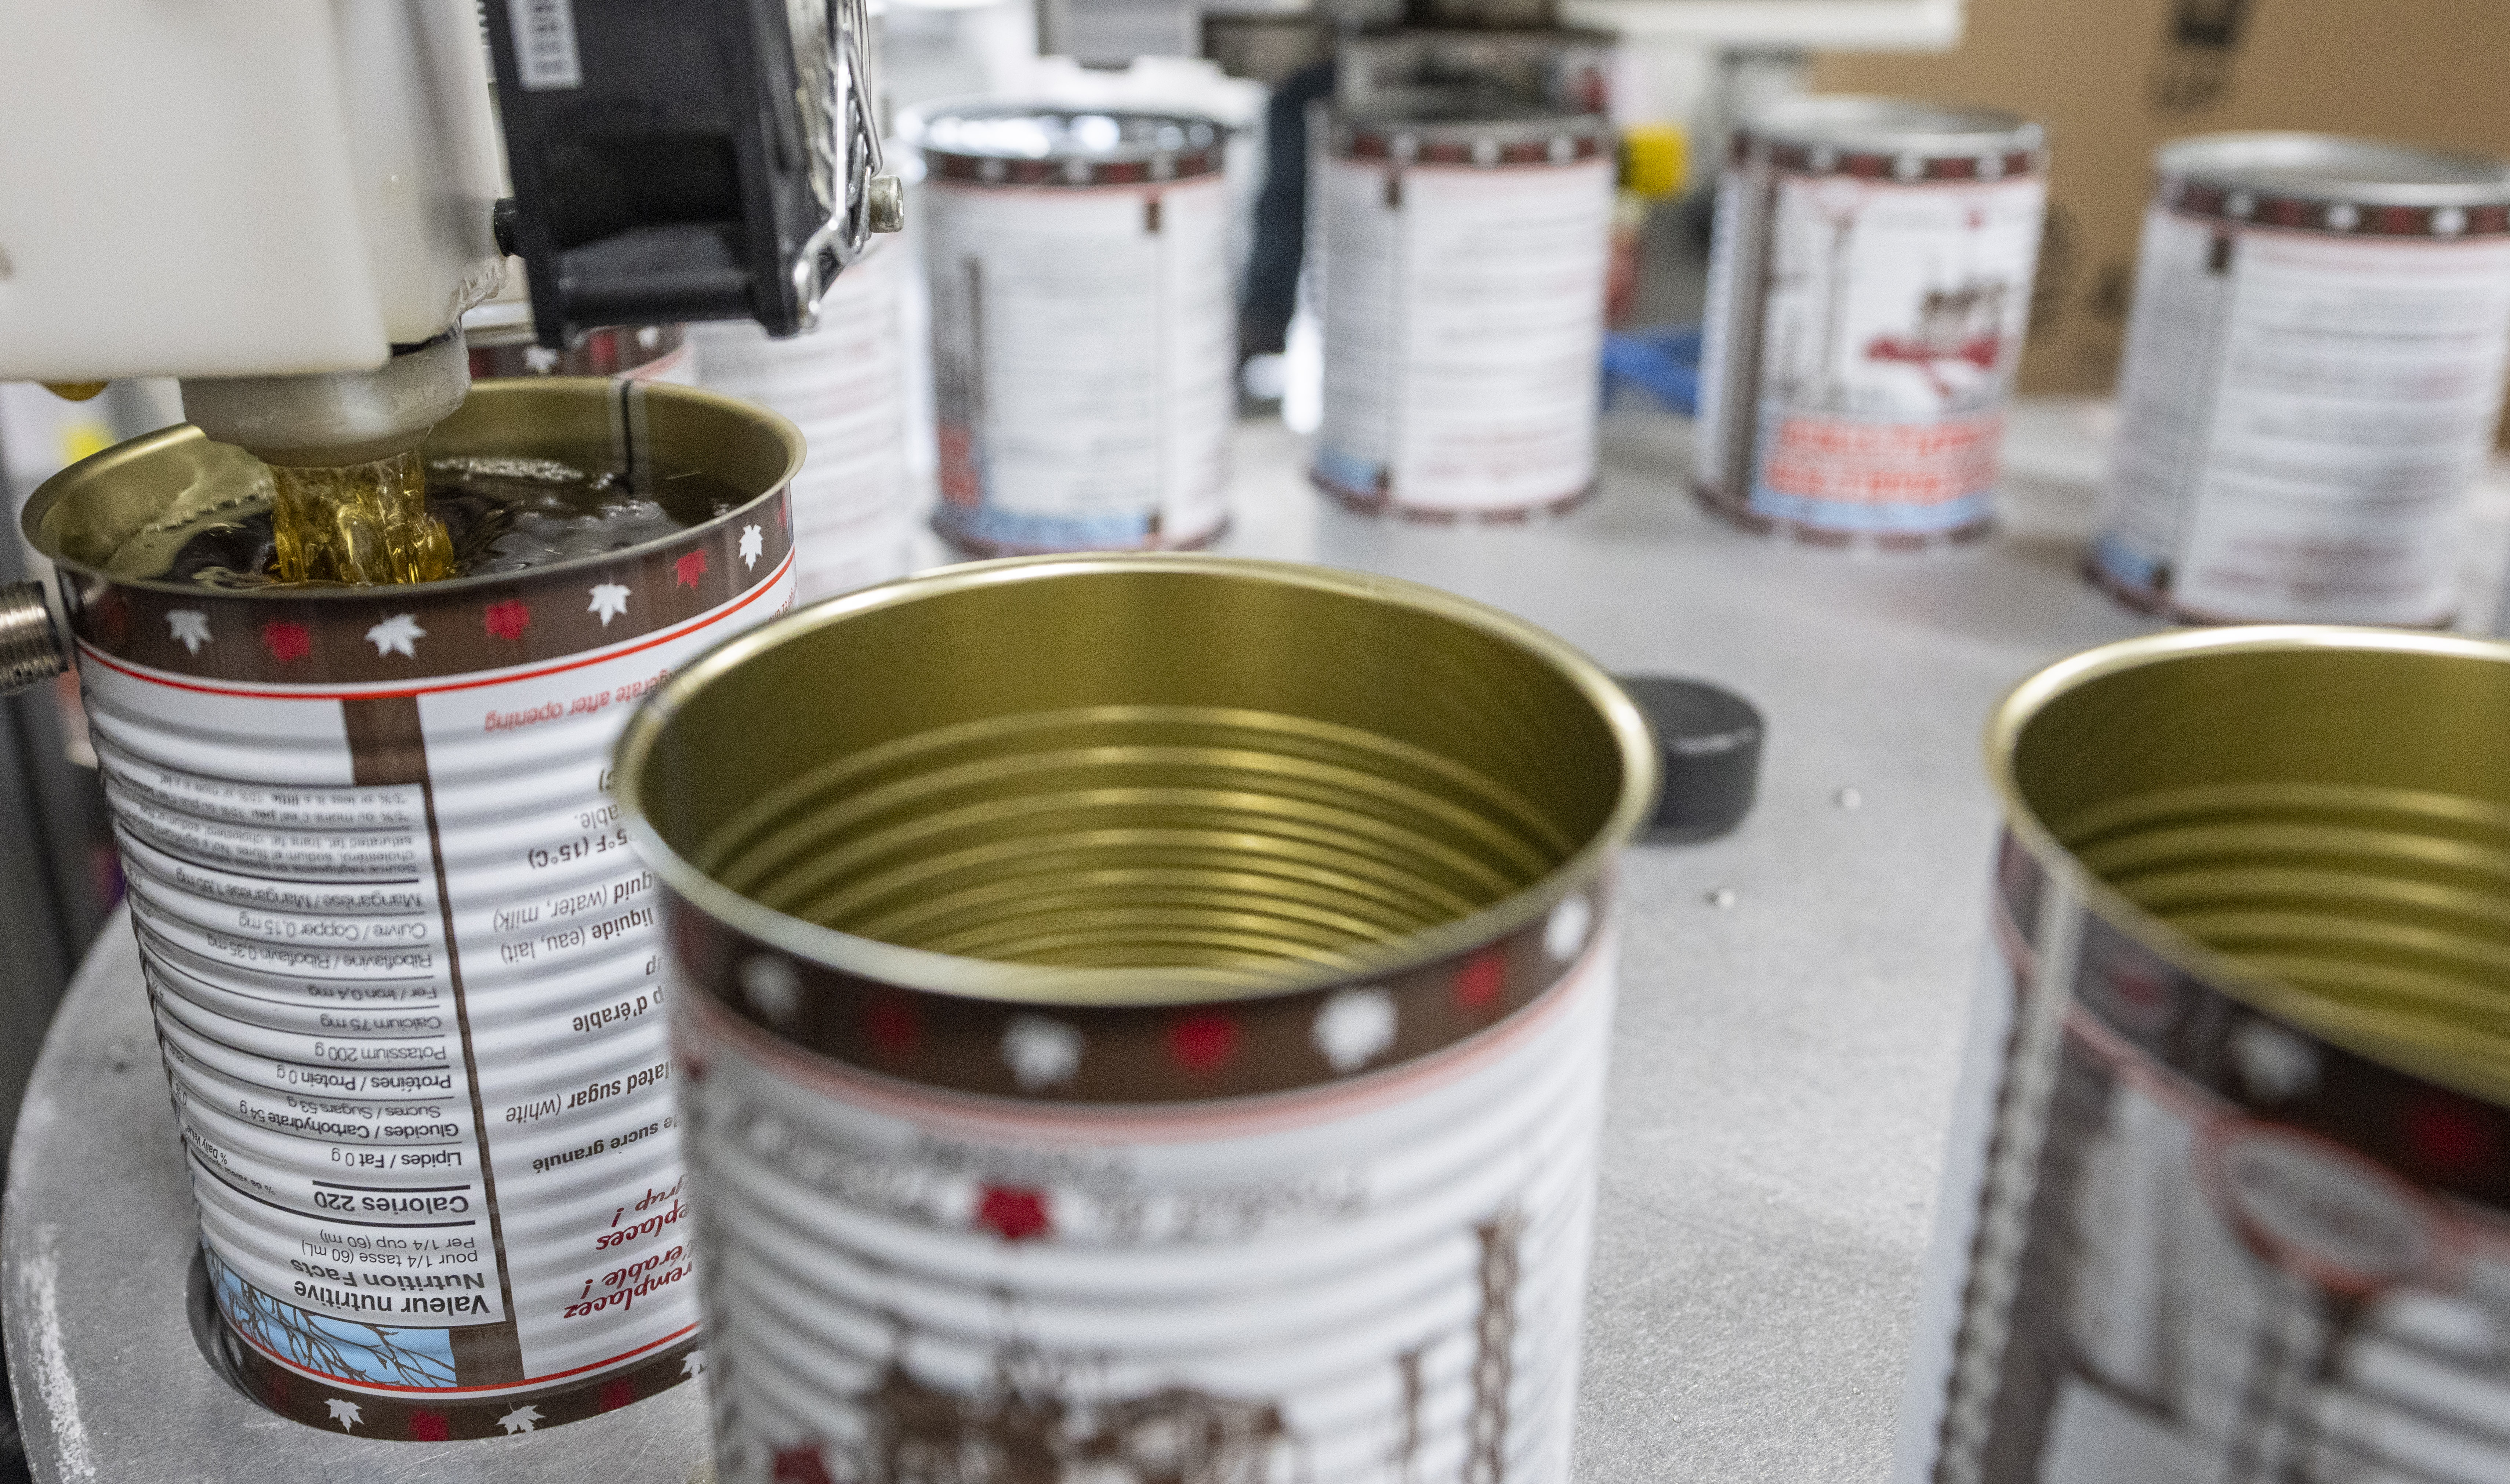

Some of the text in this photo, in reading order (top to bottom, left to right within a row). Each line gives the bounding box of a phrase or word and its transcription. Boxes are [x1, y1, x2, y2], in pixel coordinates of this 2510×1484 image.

[569, 690, 610, 715] after
[485, 701, 563, 732] opening
[527, 829, 633, 869] 5°F (15°C)
[176, 867, 195, 887] mg
[225, 885, 311, 909] Manganese
[546, 885, 607, 917] (water,
[239, 911, 261, 930] mg
[493, 906, 538, 933] milk)
[207, 933, 226, 950] mg
[300, 922, 359, 941] Copper
[373, 923, 427, 940] Cuivre
[501, 908, 653, 964] liquide (eau, lait)
[260, 947, 330, 969] Riboflavin
[343, 953, 431, 970] Riboflavine
[307, 985, 334, 997] mg
[365, 989, 396, 1000] Iron
[410, 987, 437, 999] Fer
[320, 1015, 442, 1031] Calcium 75 mg
[572, 996, 648, 1032] d'érable
[314, 1042, 446, 1062] Potassium 200 g
[276, 1065, 451, 1092] Protéines / Protein 0 g
[506, 1059, 672, 1123] lated sugar (white
[287, 1096, 440, 1119] Sucres / Sugars 53 g
[240, 1100, 458, 1139] Glucides / Carbohydrate 54 g
[610, 1123, 658, 1149] sucre
[202, 1139, 218, 1159] Daily
[220, 1152, 227, 1165] %
[331, 1147, 461, 1169] Lipides / Fat 0 g
[533, 1140, 604, 1173] granulé
[314, 1192, 469, 1214] Calories 220
[611, 1208, 624, 1227] !
[320, 1229, 475, 1251] Per 1/4 cup (60 ml)
[302, 1240, 477, 1267] pour 1/4 tasse (60 mL)
[290, 1259, 485, 1291] Nutrition Facts
[294, 1280, 490, 1316] Valeur nutritive
[564, 1262, 692, 1319] remplacez
[581, 1279, 593, 1299] !
